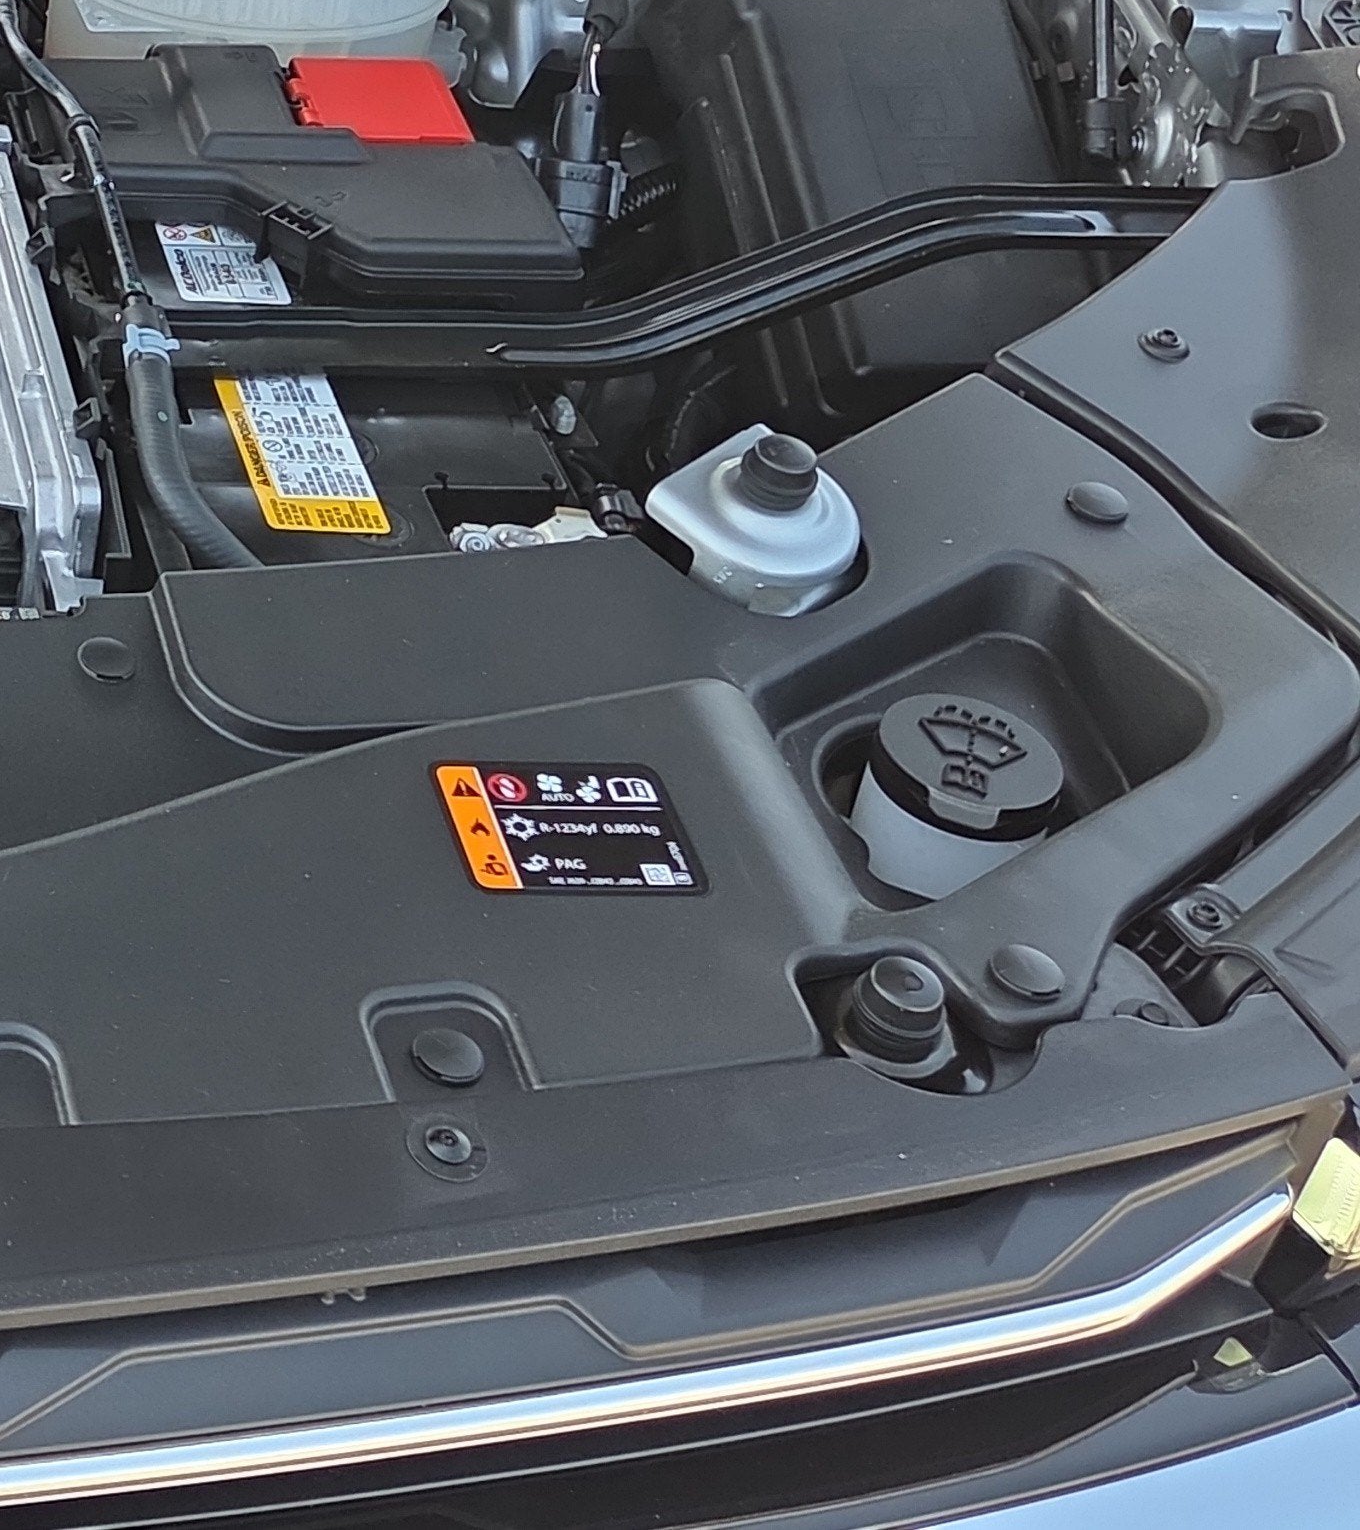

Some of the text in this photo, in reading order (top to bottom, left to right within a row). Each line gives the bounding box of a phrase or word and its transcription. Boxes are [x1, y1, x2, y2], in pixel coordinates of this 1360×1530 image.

[541, 792, 575, 803] AUTO
[539, 821, 598, 836] R-1234yf
[641, 823, 662, 837] kg
[555, 857, 587, 870] PAG
